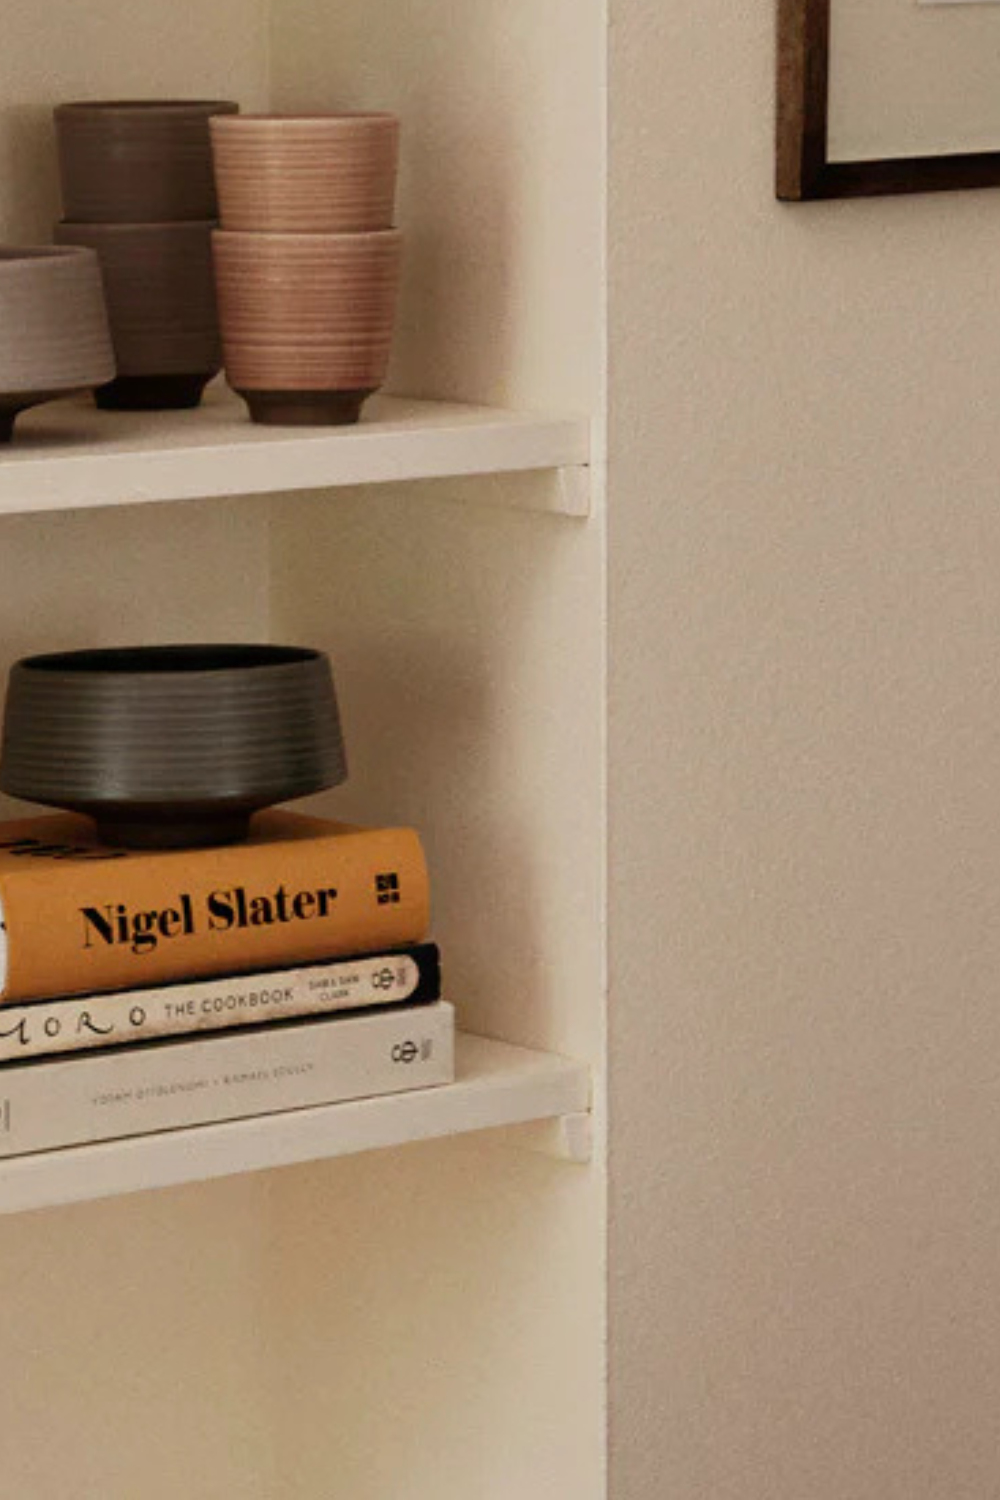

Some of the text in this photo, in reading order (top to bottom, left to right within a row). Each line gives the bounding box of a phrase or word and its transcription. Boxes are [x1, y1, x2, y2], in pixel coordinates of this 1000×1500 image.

[79, 893, 195, 955] Nigel
[207, 885, 338, 931] Slater
[164, 1000, 196, 1017] THE
[201, 989, 294, 1013] COOKBOOK
